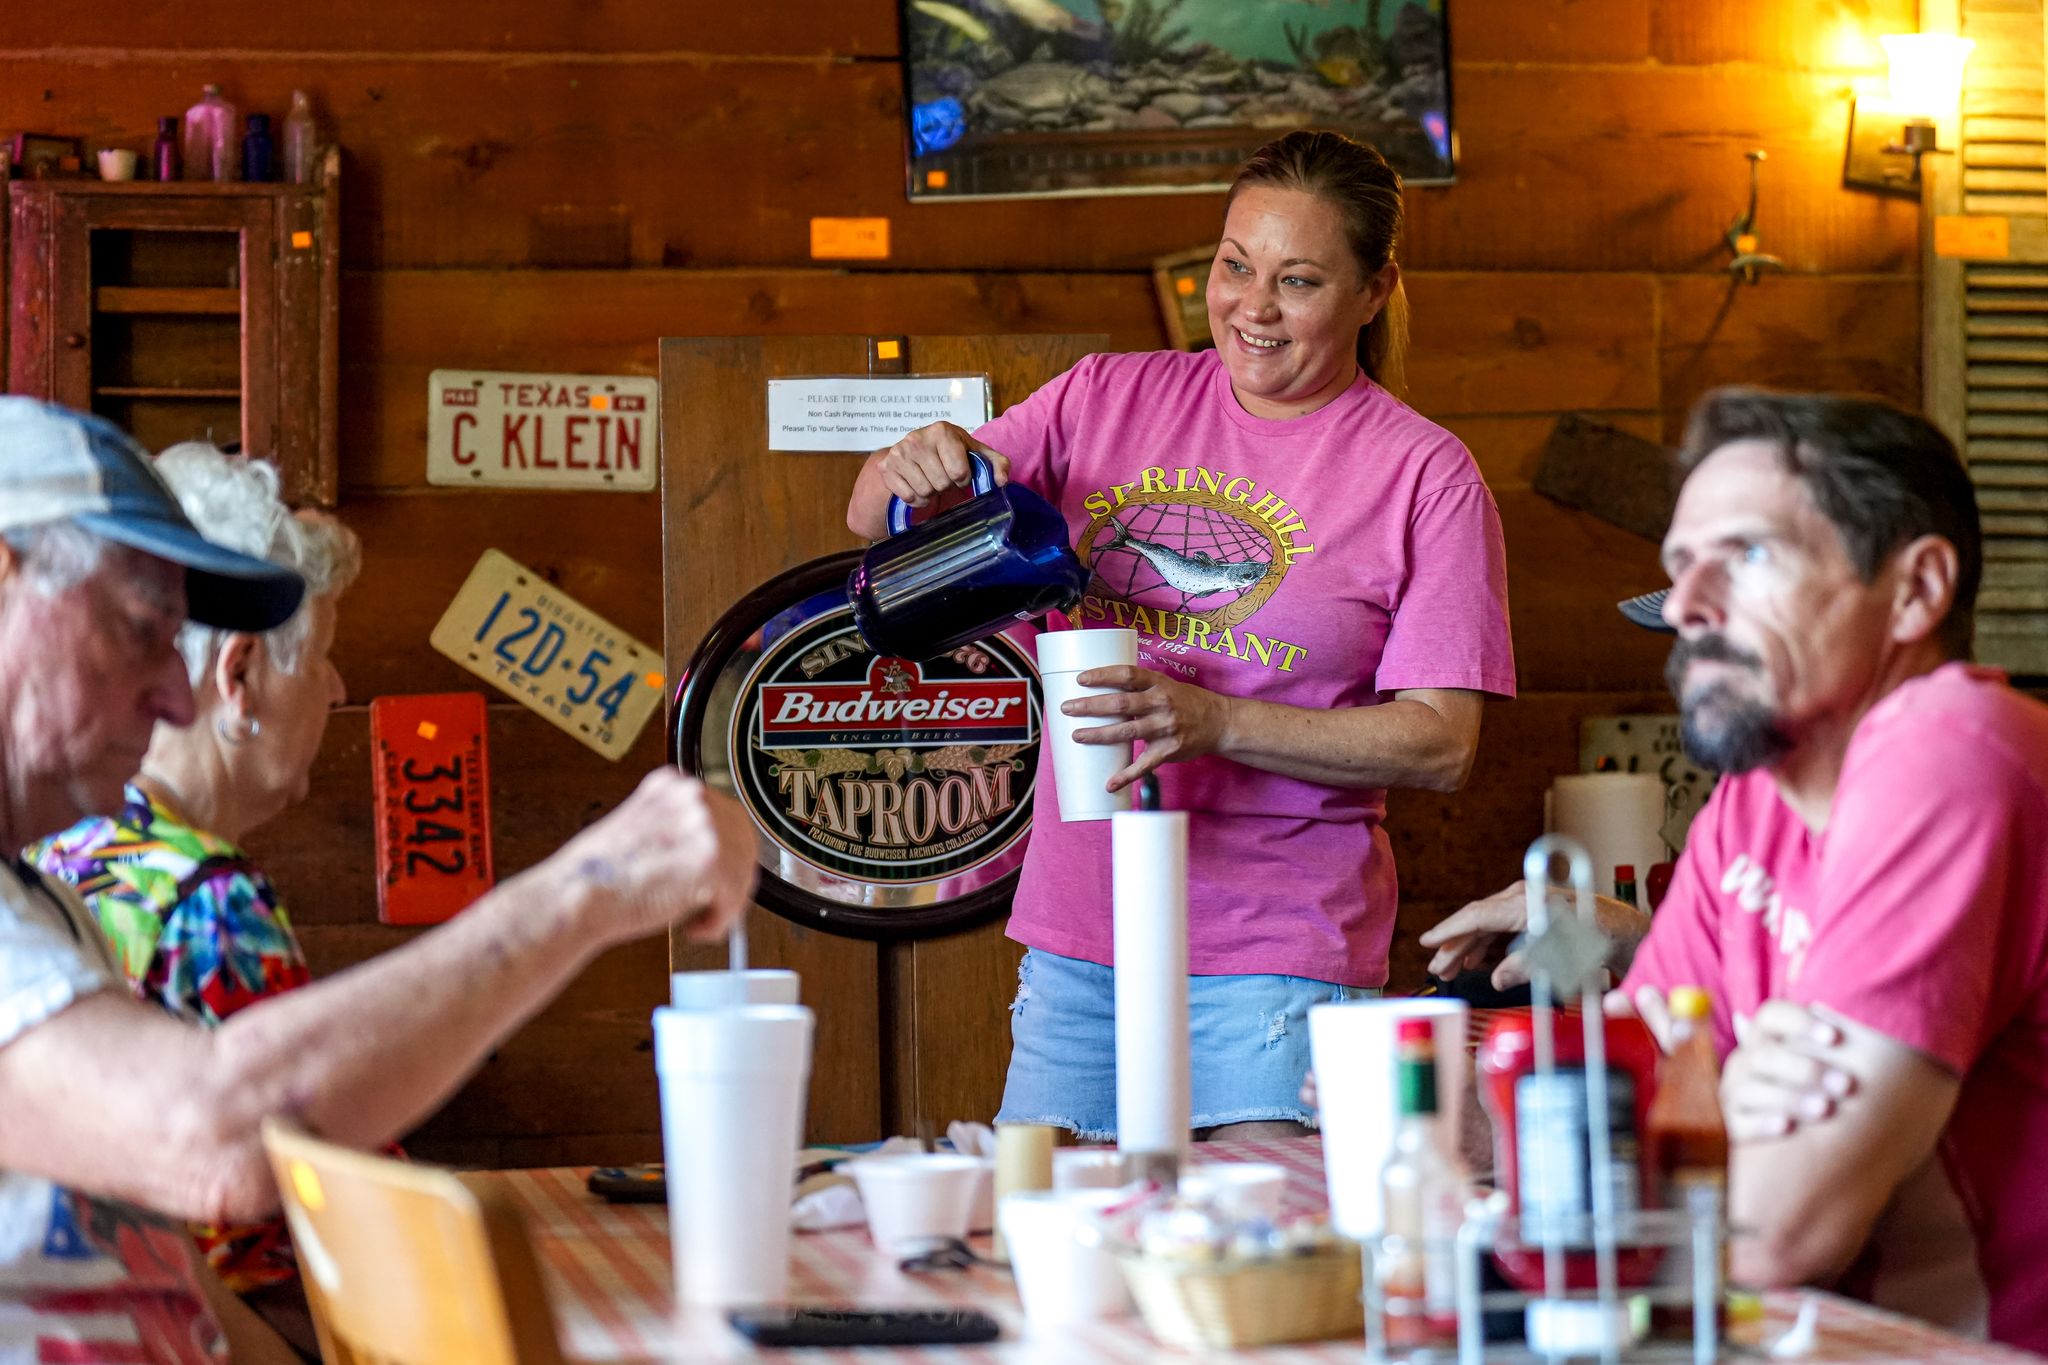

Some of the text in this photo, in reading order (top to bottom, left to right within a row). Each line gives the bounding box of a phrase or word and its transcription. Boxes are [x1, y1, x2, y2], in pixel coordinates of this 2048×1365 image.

[499, 383, 590, 408] TEXAS
[807, 395, 952, 403] PLEASE TIP FOR GREAT SERVICE
[842, 411, 876, 419] Payments
[452, 412, 641, 470] C KLEIN
[1081, 594, 1308, 672] STAURANT
[1157, 640, 1190, 655] 1985
[495, 659, 573, 717] TEXAS
[770, 690, 1022, 723] Budweiser
[829, 732, 961, 742] KING OF BEERS
[403, 756, 464, 877] 3342
[778, 764, 1014, 846] TAPROOM
[807, 823, 989, 860] FEATURING THE BUDWEISER ARCHIVES COLLECTION
